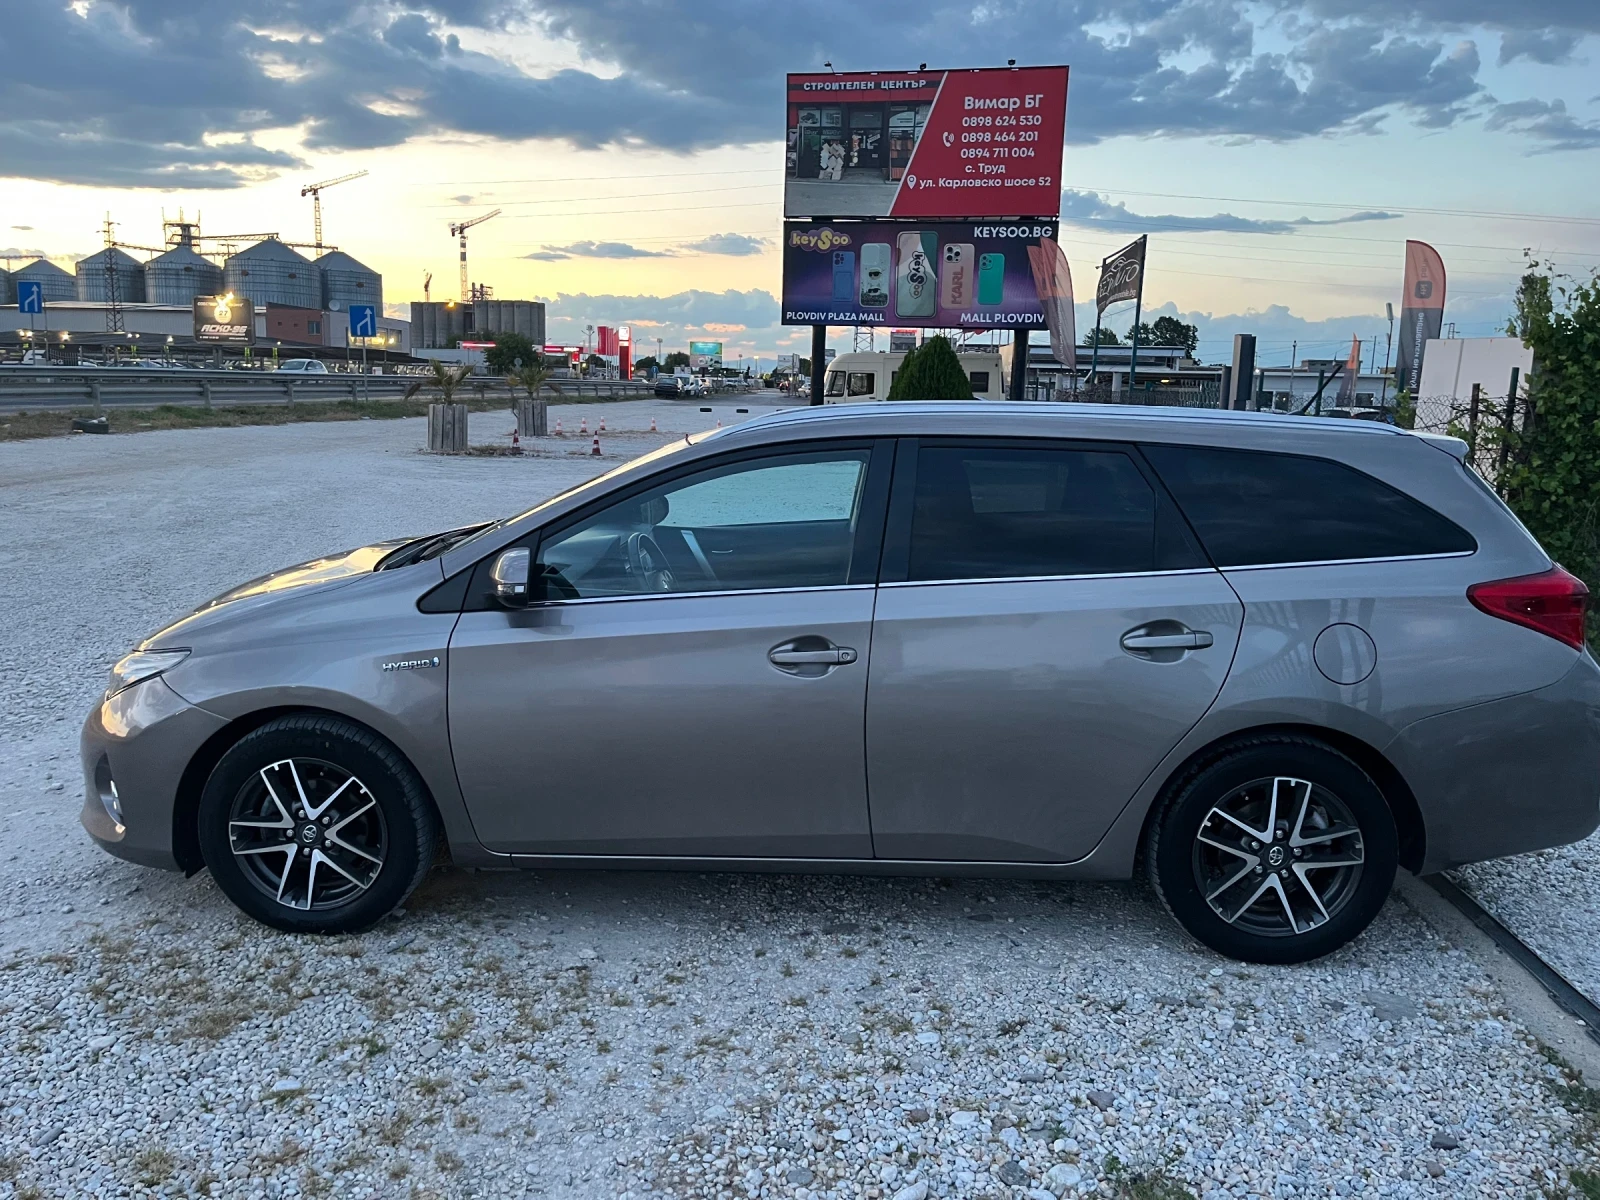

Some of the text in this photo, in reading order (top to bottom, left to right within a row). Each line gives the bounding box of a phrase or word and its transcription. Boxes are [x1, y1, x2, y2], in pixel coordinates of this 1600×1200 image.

[803, 79, 927, 91] СТРОИТЕЛЕН ЦЕНТЪР
[964, 94, 1044, 112] Вимар БГ
[962, 115, 1042, 127] 0898 624 530
[961, 131, 1039, 143] 0898 464 201
[960, 147, 1035, 159] 0894 711 004
[964, 163, 1006, 175] с. Труд
[919, 177, 1051, 189] ул. Карловско шосе 52
[973, 226, 1053, 239] KEYSOO.BG
[950, 265, 964, 305] KARL
[786, 311, 885, 322] PLOVDIV PLAZA MALL
[960, 312, 1045, 324] MALL PLOVDIV
[382, 659, 430, 671] HYBRID
